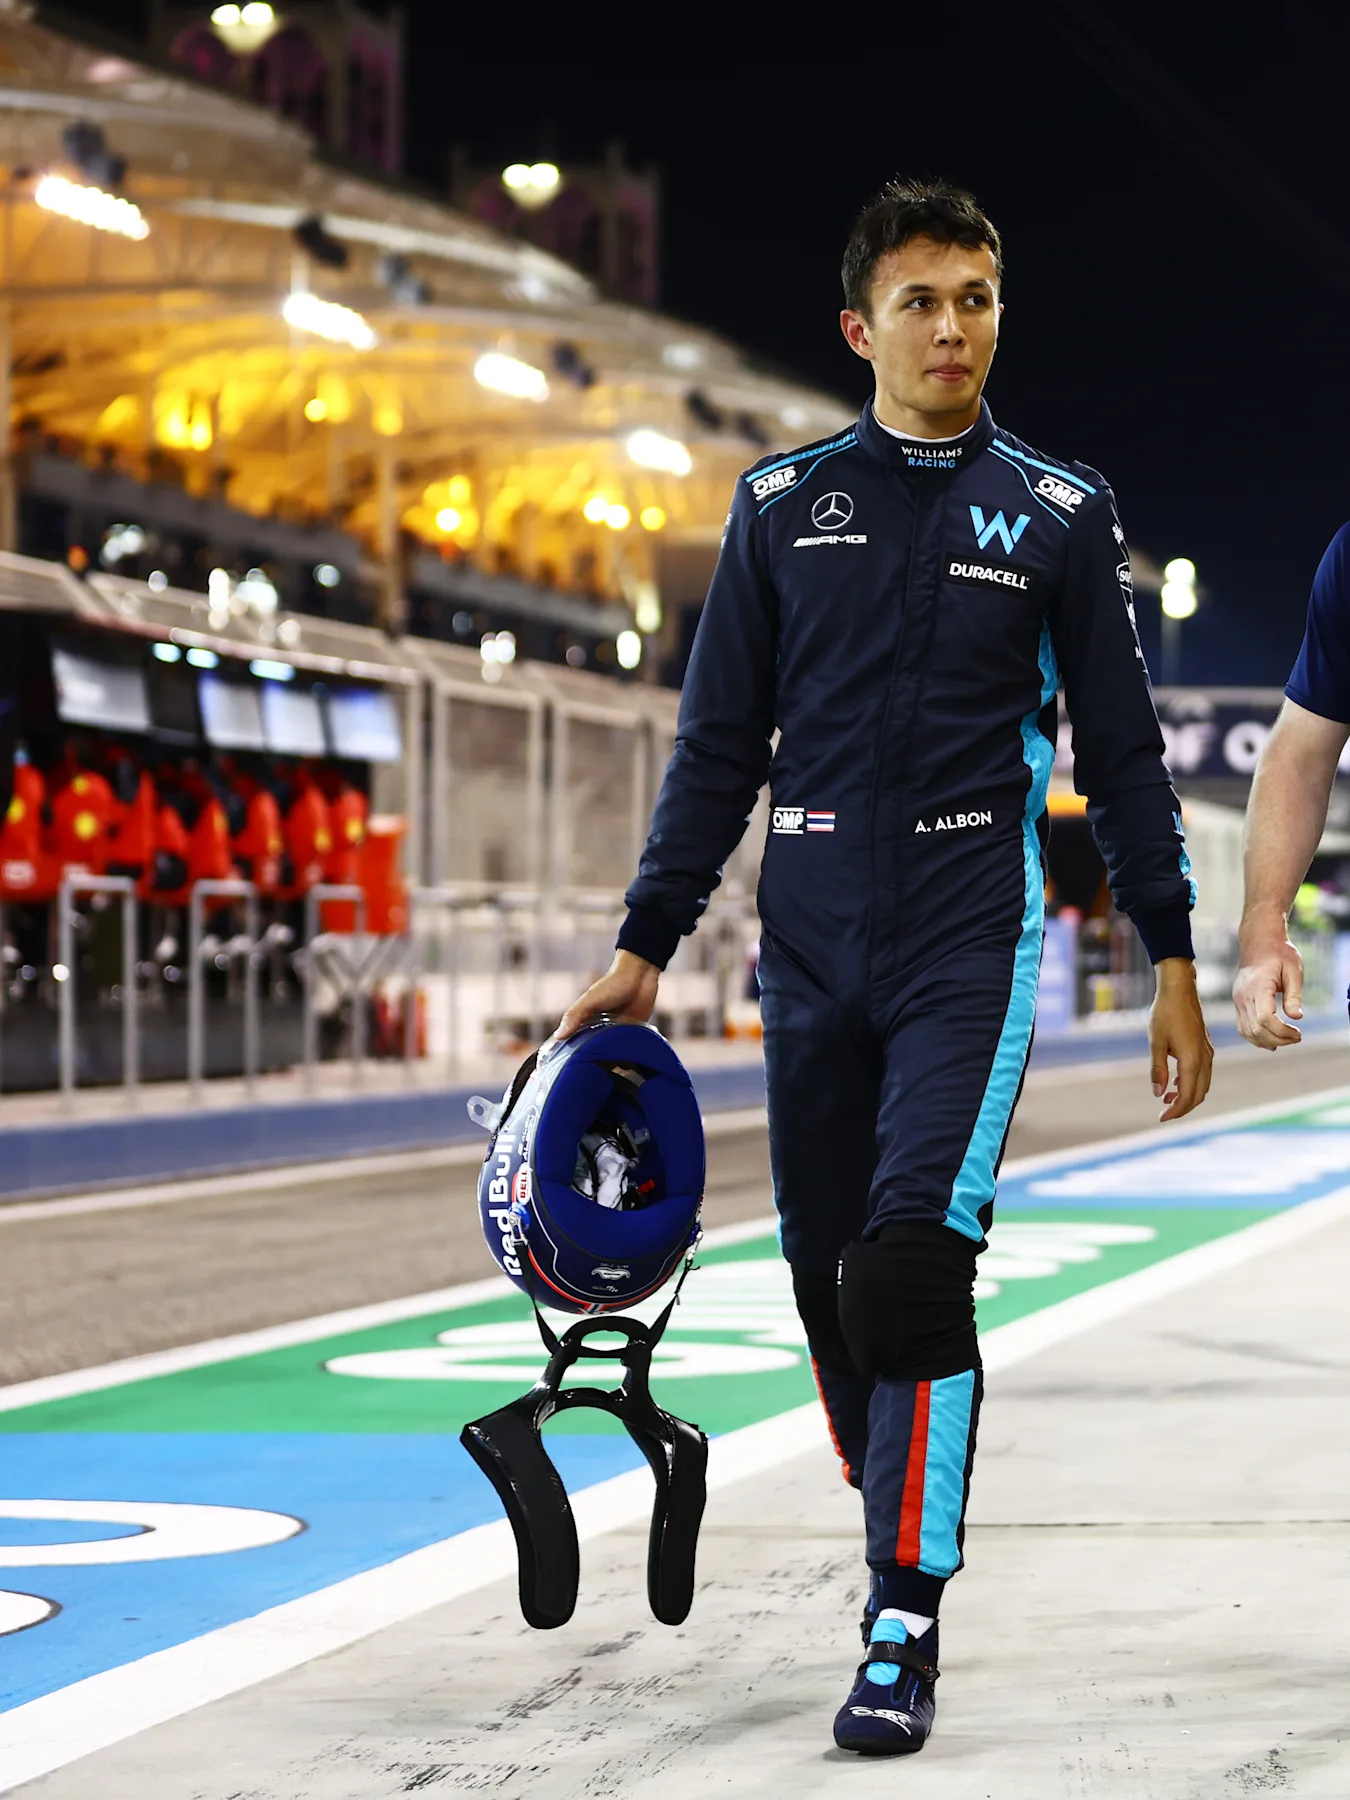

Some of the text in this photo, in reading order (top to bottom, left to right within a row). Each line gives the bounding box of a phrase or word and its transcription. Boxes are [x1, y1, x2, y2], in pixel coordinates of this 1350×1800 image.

[901, 446, 963, 459] WILLIAMS
[907, 457, 956, 469] RACING
[752, 468, 797, 496] OMP
[1037, 478, 1083, 508] OMP
[818, 534, 868, 545] AMG
[949, 562, 1030, 590] DURACELL
[772, 811, 804, 830] OMP
[915, 810, 993, 834] A. ALBON
[488, 1133, 523, 1276] Red Bull
